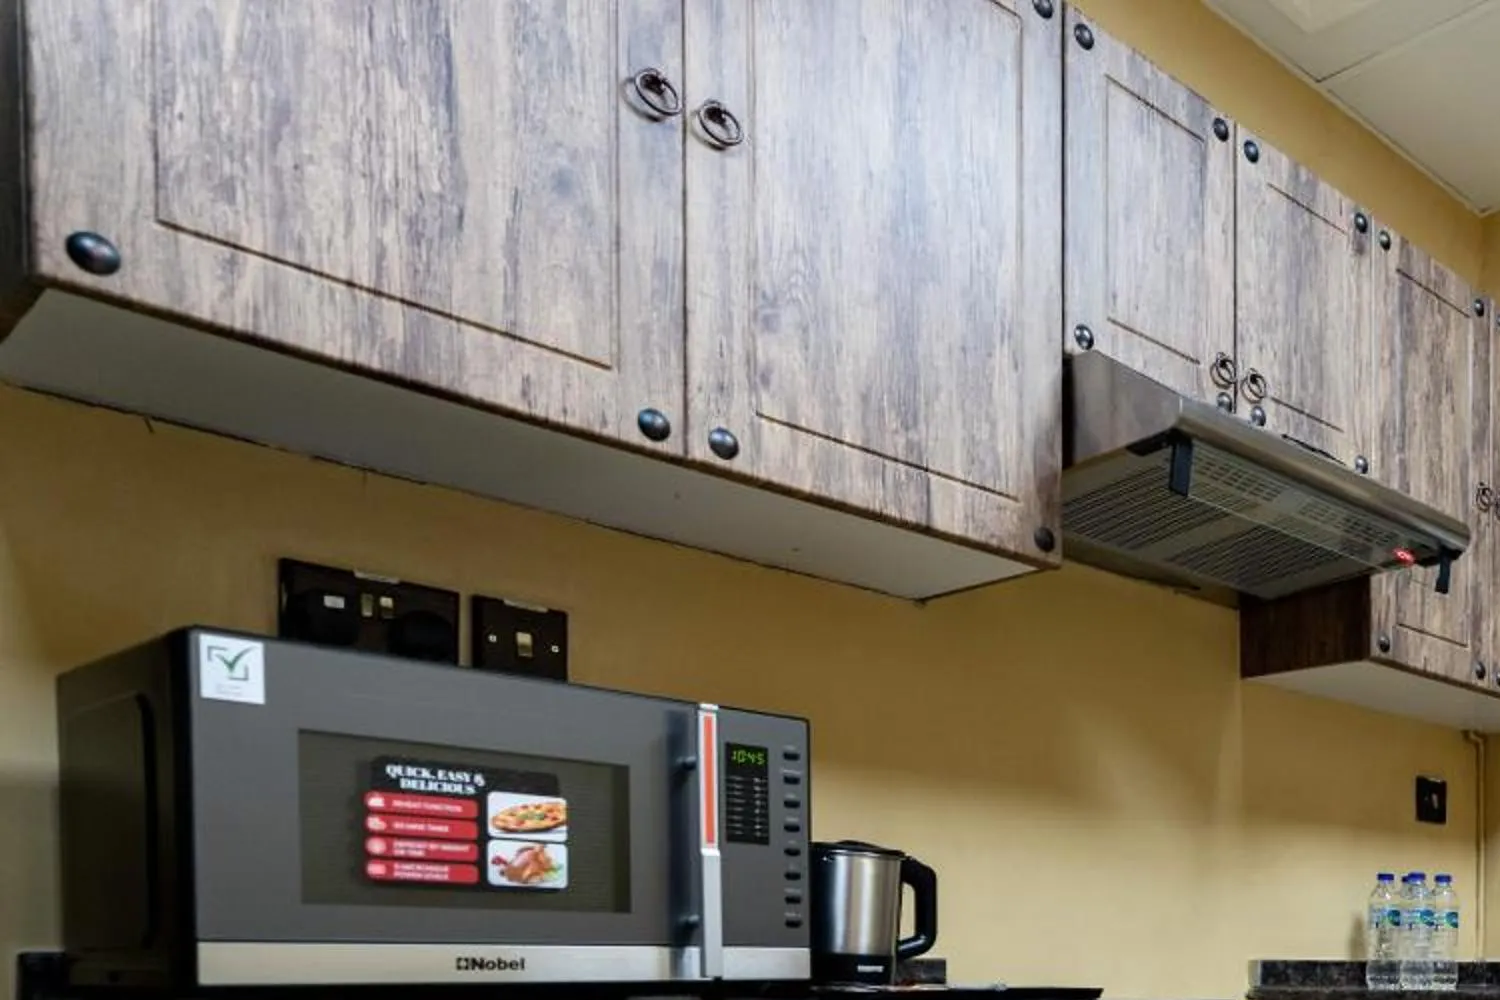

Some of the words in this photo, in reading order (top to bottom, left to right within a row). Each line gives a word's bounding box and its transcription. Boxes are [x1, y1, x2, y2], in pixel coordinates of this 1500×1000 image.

[437, 769, 472, 783] EASY
[400, 778, 476, 795] DELICIOUS
[471, 957, 526, 971] Nobel
